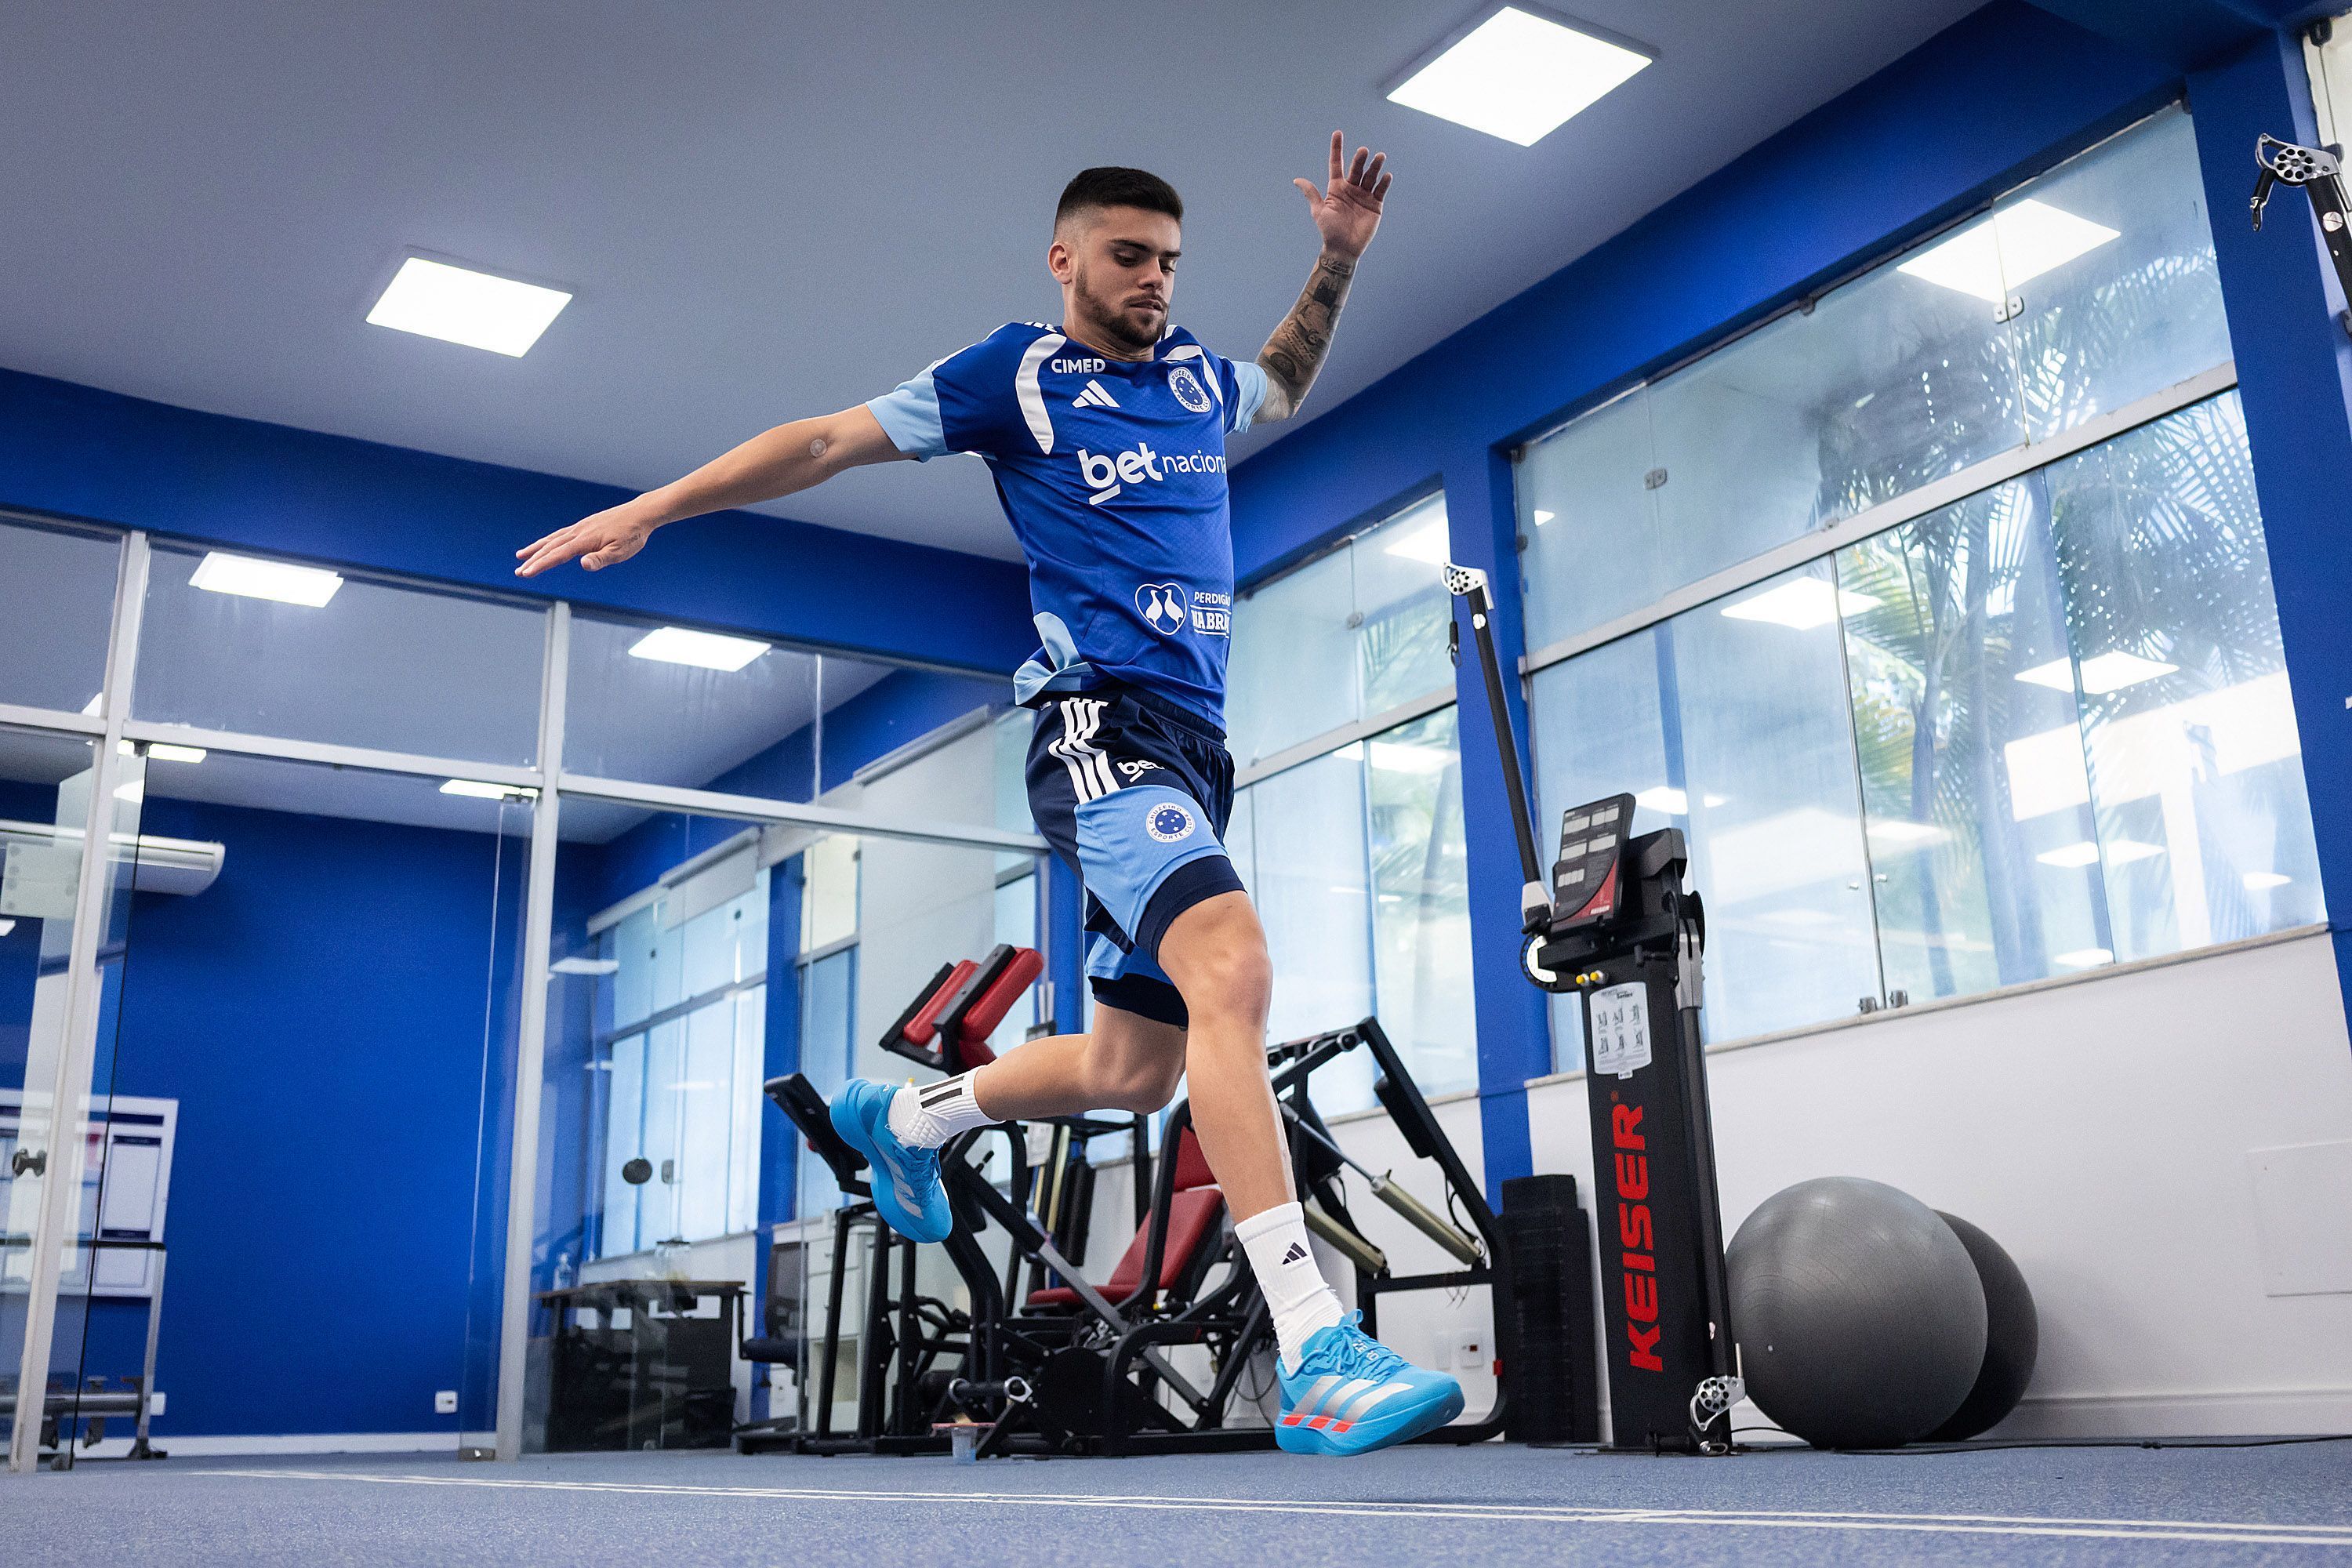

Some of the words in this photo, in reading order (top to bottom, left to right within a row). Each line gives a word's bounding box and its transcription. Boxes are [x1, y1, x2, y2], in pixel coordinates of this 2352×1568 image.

[1051, 358, 1105, 373] CIMED
[1171, 370, 1195, 385] CRUZEIRO
[1149, 804, 1182, 825] CRUZEIRO
[1151, 827, 1184, 840] ESPORTE
[1612, 1104, 1663, 1372] KEISER
